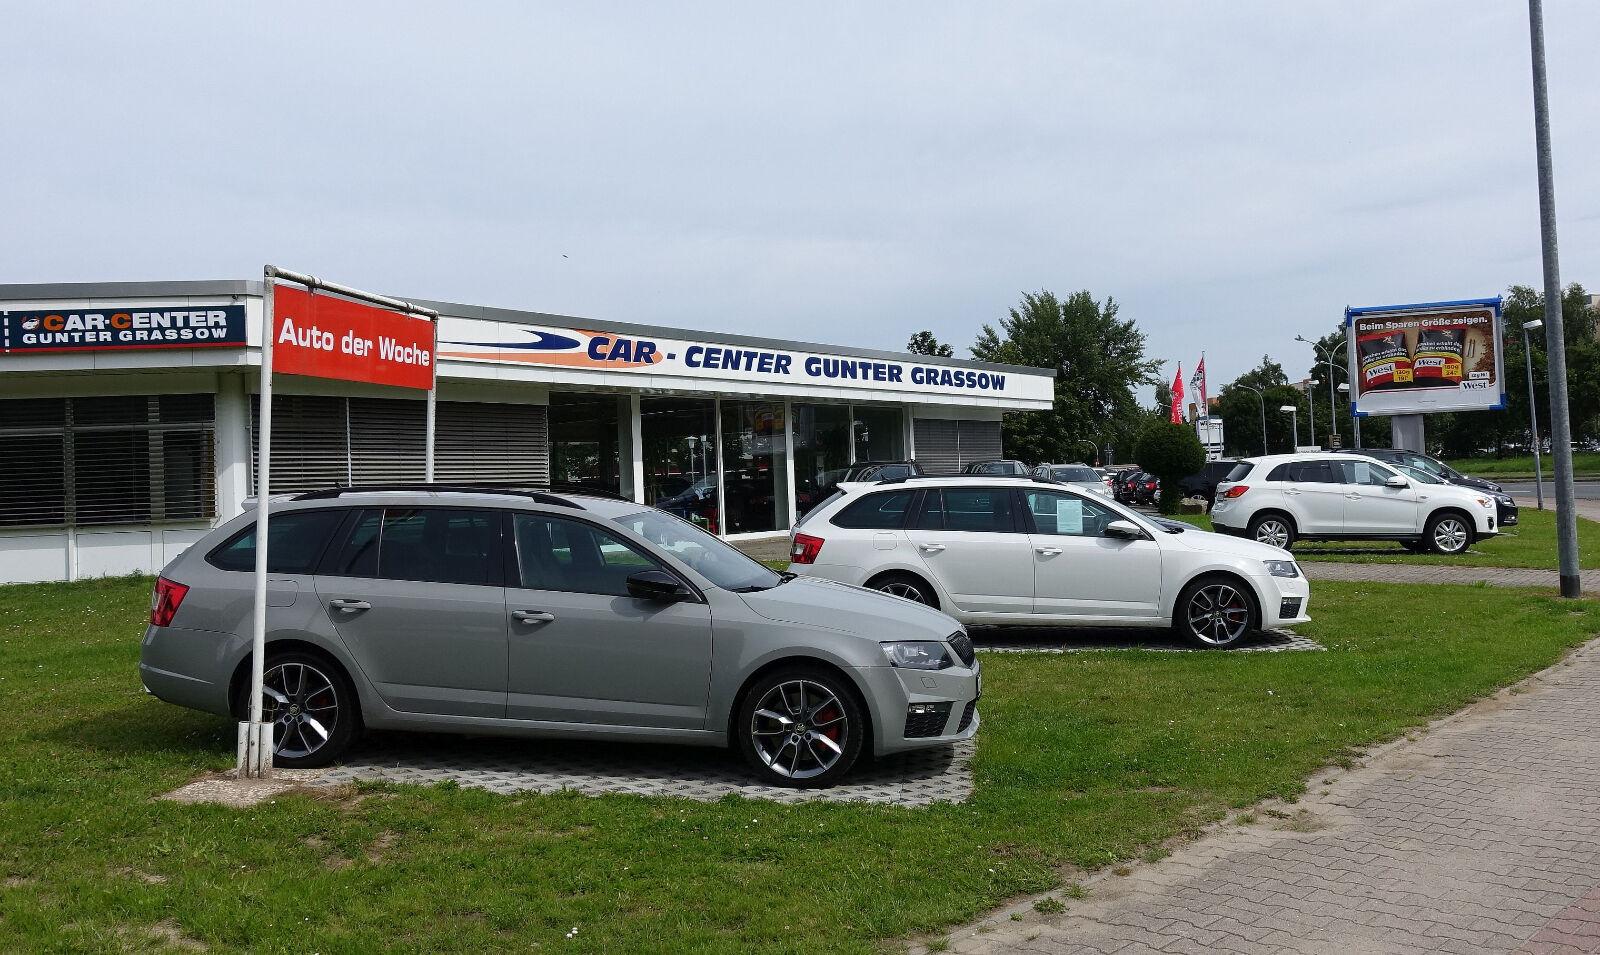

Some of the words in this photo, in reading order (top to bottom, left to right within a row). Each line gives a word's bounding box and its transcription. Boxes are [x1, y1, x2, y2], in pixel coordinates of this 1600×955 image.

[43, 310, 227, 331] CAR-CENTER
[1360, 322, 1384, 331] Beim
[1385, 320, 1420, 329] Sparen
[1421, 318, 1451, 327] Größe
[1452, 316, 1488, 325] zeigen.
[22, 331, 112, 344] GUNTER
[118, 328, 228, 342] GRASSOW
[278, 317, 334, 351] Auto
[341, 329, 373, 357] der
[378, 335, 430, 367] Woche
[587, 336, 657, 365] CAR
[684, 345, 792, 375] CENTER
[804, 356, 903, 383] GUNTER
[910, 366, 1006, 391] GRASSOW
[1368, 364, 1394, 377] West
[1462, 381, 1487, 390] West
